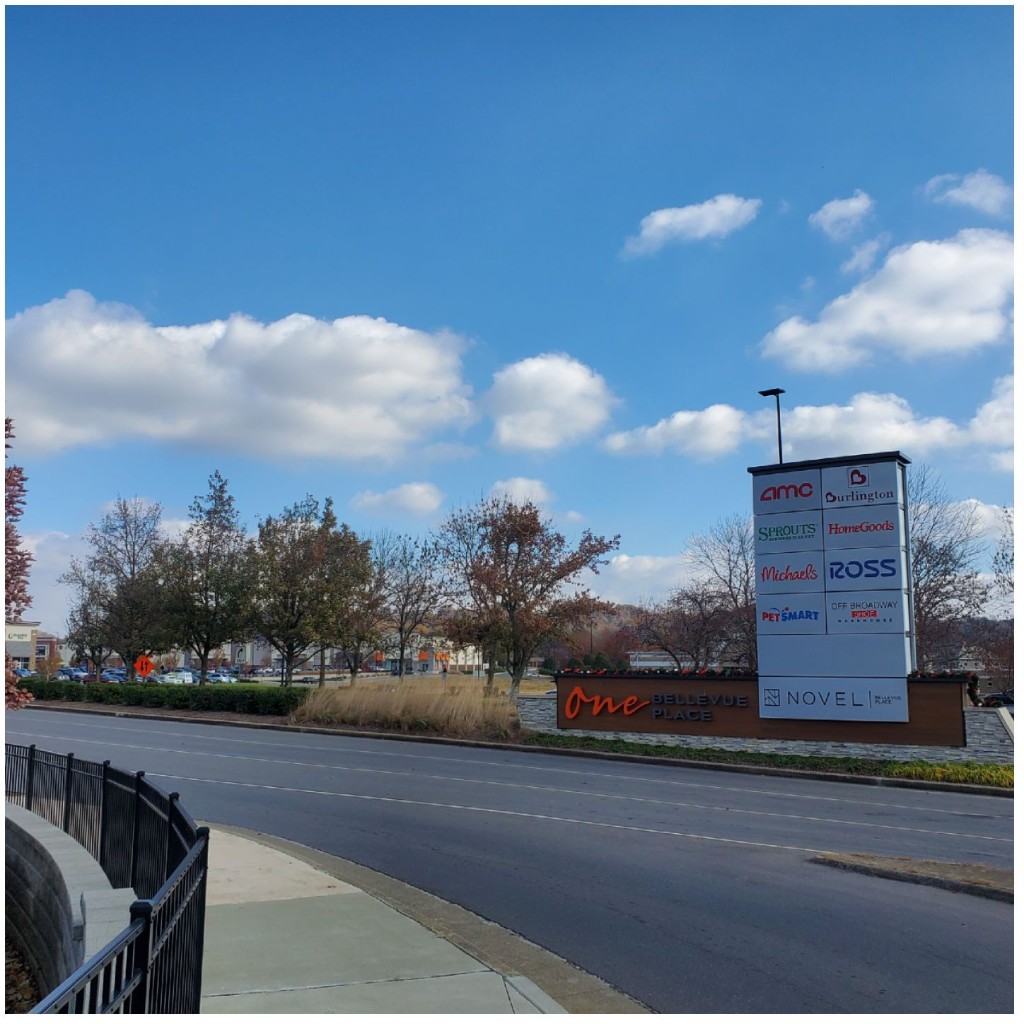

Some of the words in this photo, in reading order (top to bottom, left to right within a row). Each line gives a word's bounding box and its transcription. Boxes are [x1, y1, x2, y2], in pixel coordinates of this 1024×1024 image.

[826, 491, 894, 504] Burlington
[758, 523, 816, 541] SPROUTS
[828, 520, 894, 535] HomeGoods
[760, 564, 818, 582] Michaels
[829, 559, 896, 579] ROSS
[831, 602, 847, 610] OFF
[850, 601, 898, 609] BROADWAY
[564, 686, 651, 719] One
[652, 693, 748, 707] BELLEVUE
[787, 691, 864, 707] NOVEL
[652, 709, 712, 721] PLACE
